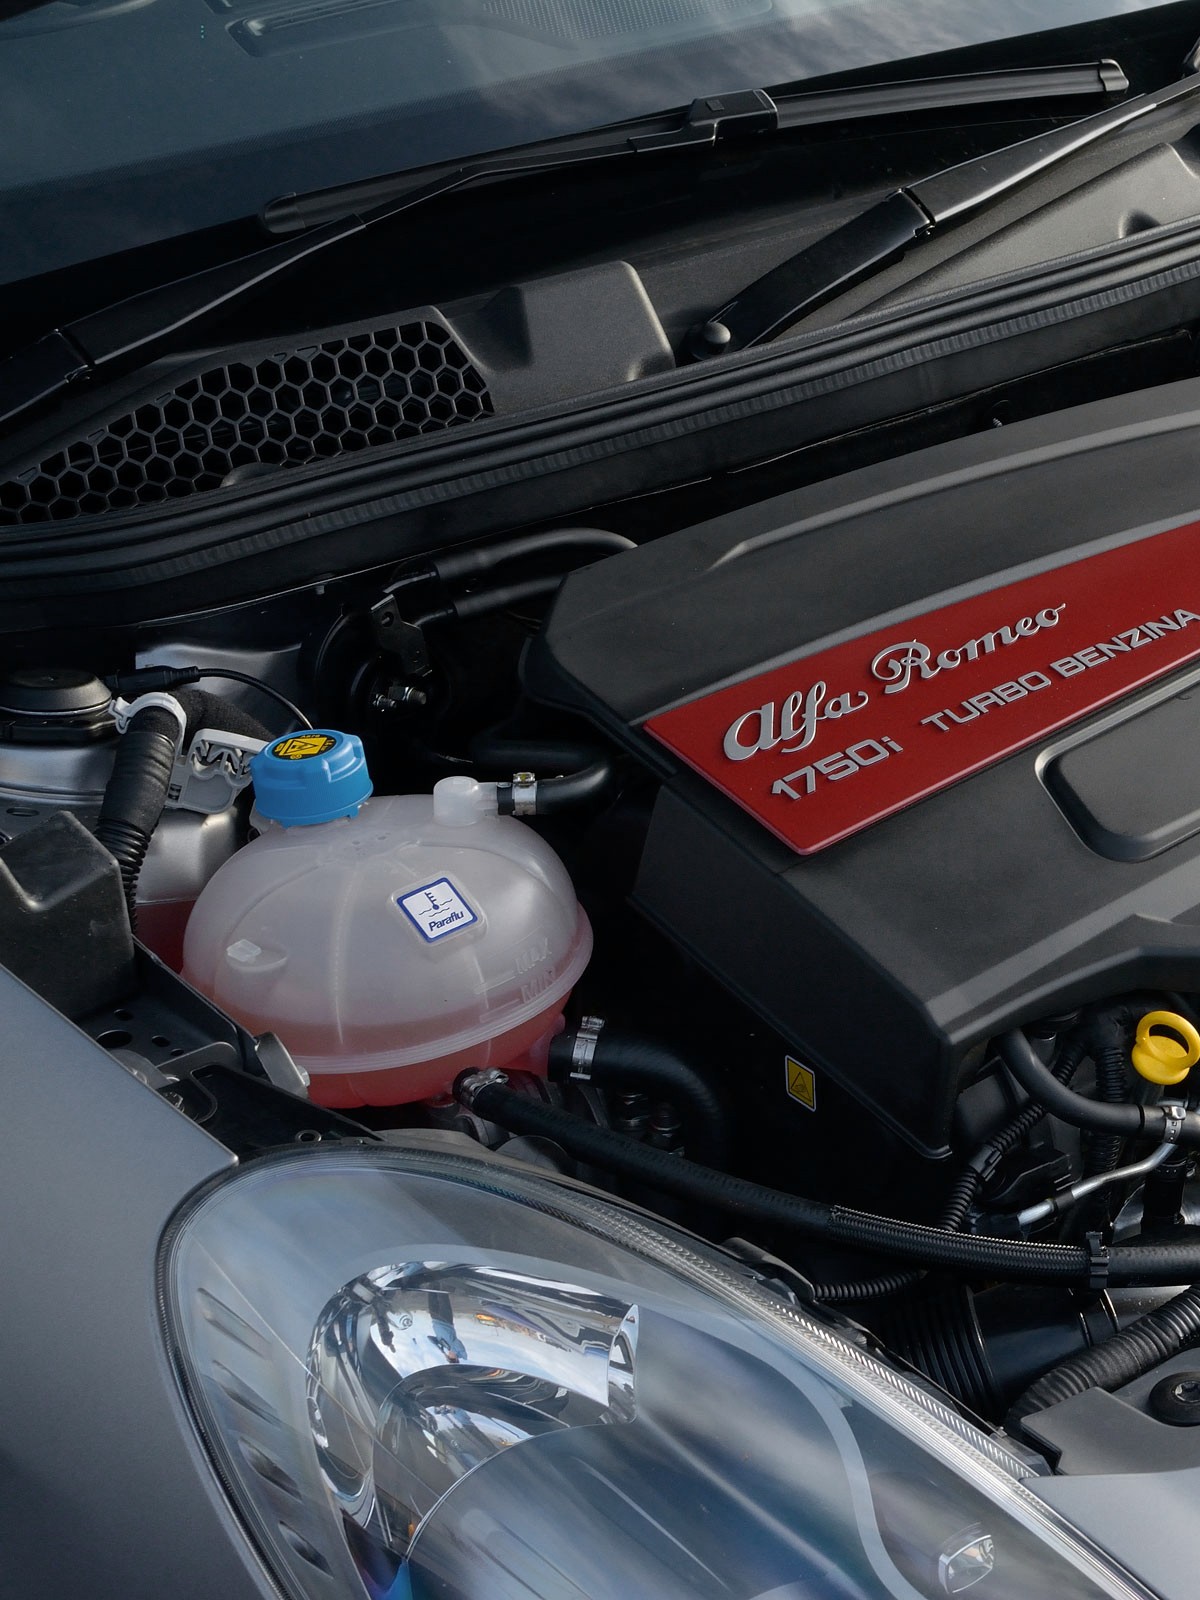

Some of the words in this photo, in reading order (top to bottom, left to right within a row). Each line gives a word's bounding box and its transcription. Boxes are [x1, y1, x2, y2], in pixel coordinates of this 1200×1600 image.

[723, 681, 868, 762] Alfa
[871, 603, 1066, 694] Romeo
[921, 671, 1052, 732] TURBO
[771, 735, 904, 801] 1750i
[428, 911, 464, 931] Paraflu
[514, 937, 552, 974] MAX
[520, 966, 557, 1004] MIN
